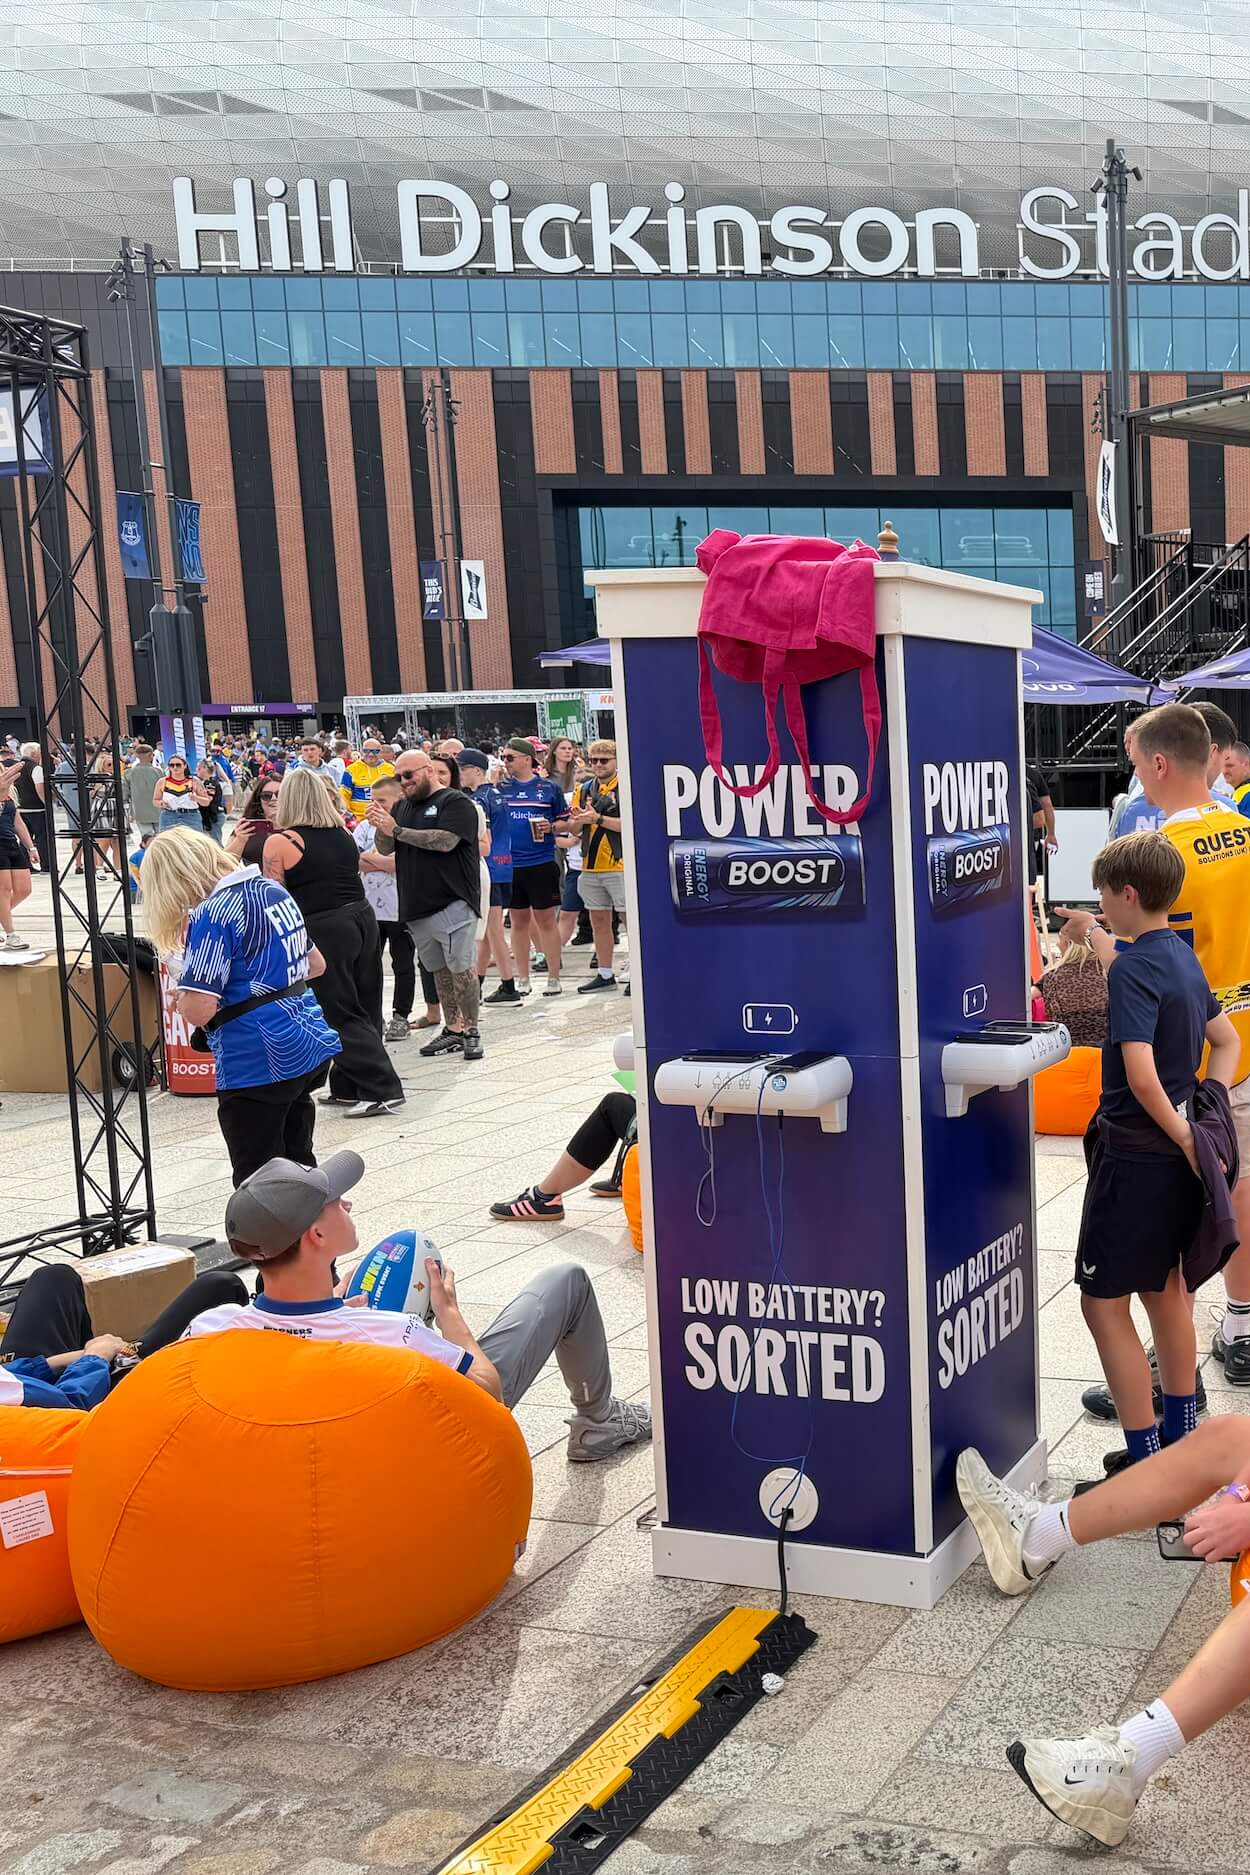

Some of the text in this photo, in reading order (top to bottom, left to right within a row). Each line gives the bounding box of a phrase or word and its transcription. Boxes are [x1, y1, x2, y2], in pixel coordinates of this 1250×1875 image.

[172, 176, 355, 272] Hill
[399, 178, 980, 277] Dickinson
[663, 763, 861, 838] POWER
[923, 761, 1010, 836] POWER
[684, 853, 694, 897] ORIGINAL
[693, 846, 712, 903] ENERGY
[727, 858, 838, 887] BOOST
[954, 845, 1001, 879] BOOST
[1198, 850, 1234, 865] SOLUTIONS
[936, 1222, 1024, 1317] LOW BATTERY?
[681, 1278, 886, 1328] LOW BATTERY?
[937, 1267, 1024, 1391] SORTED
[683, 1323, 886, 1405] SORTED
